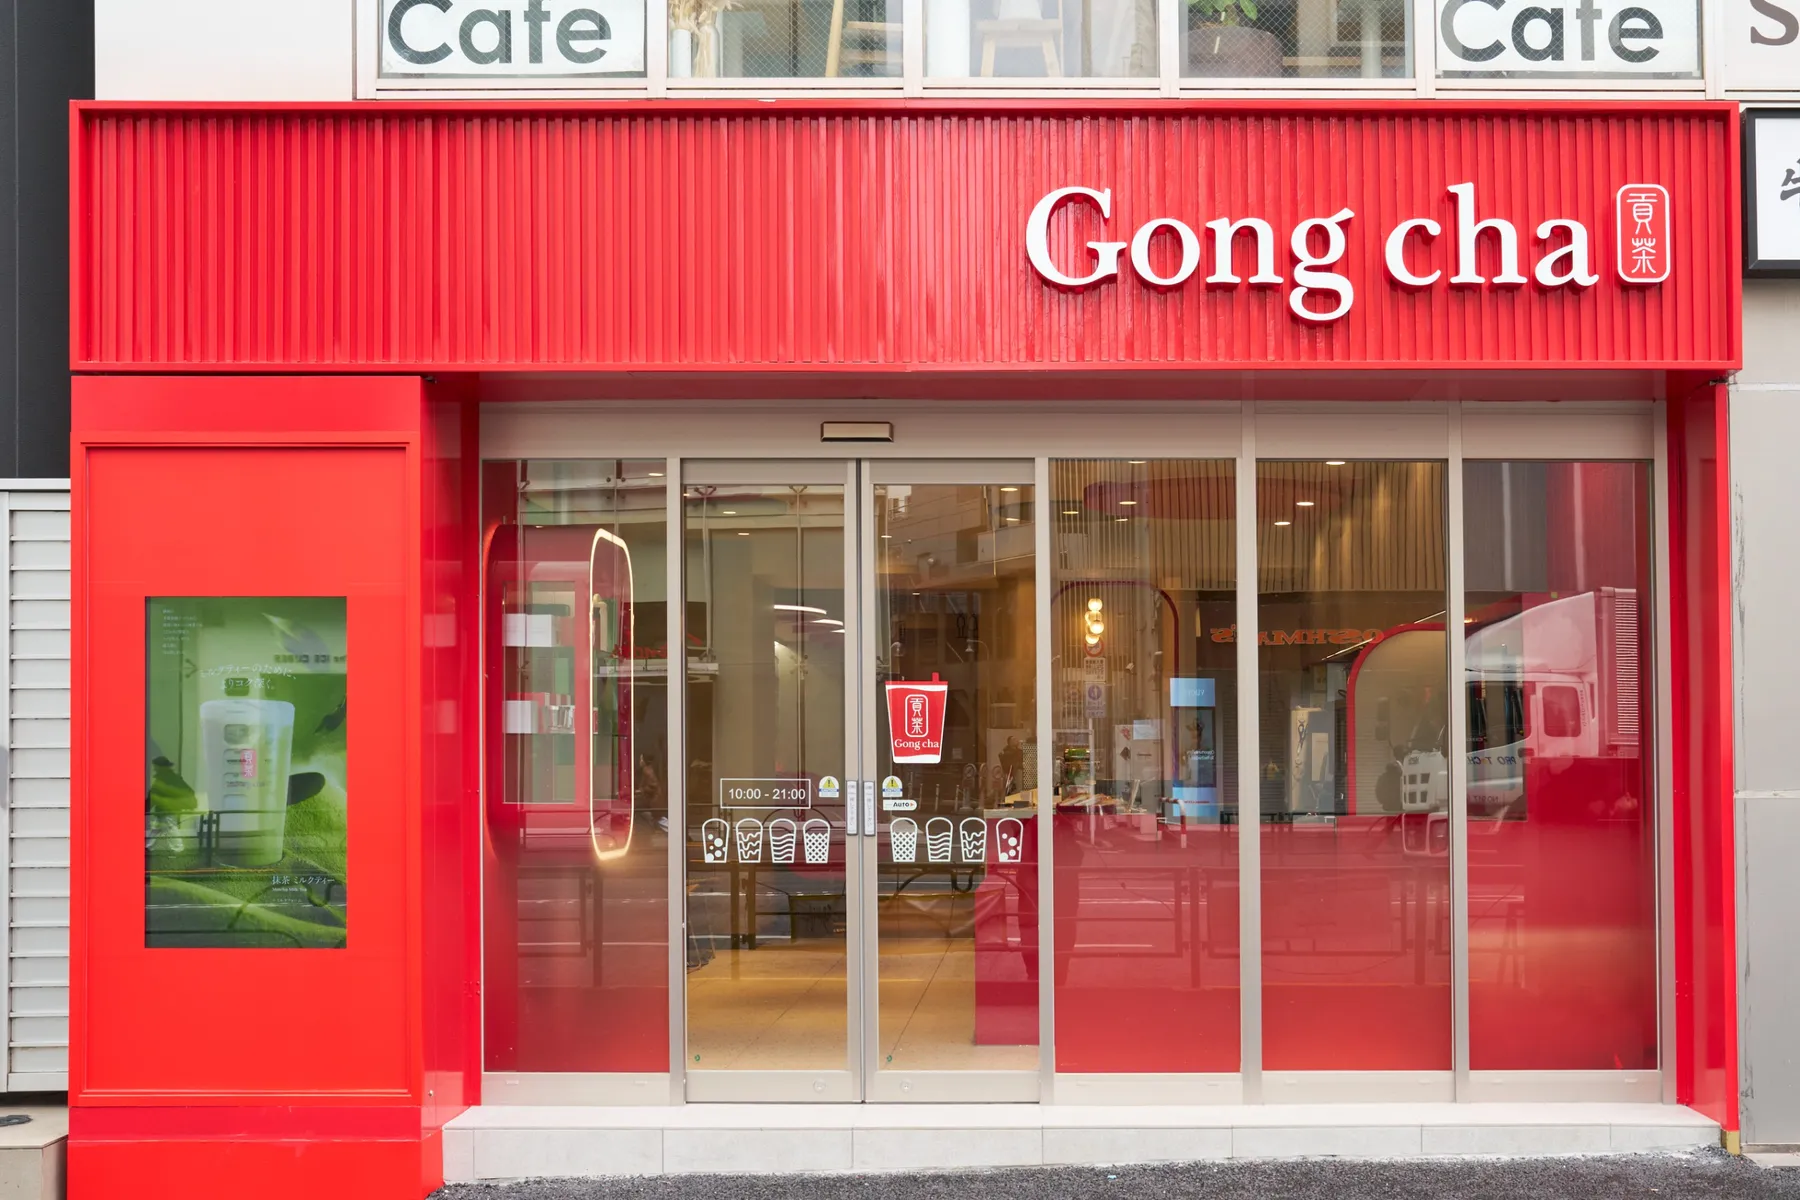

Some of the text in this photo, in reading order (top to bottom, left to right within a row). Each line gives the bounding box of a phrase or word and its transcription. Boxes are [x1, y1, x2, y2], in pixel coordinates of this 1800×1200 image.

[387, 0, 611, 64] Cafe
[1440, 0, 1664, 63] Cafe
[1026, 182, 1600, 321] Gong cha
[1626, 192, 1658, 275] 貢茶
[910, 697, 924, 734] 貢茶
[894, 738, 940, 750] Gong cha
[728, 788, 761, 800] 10:00
[772, 788, 806, 800] 21:00
[272, 875, 335, 885] 抹茶 ミルクティー
